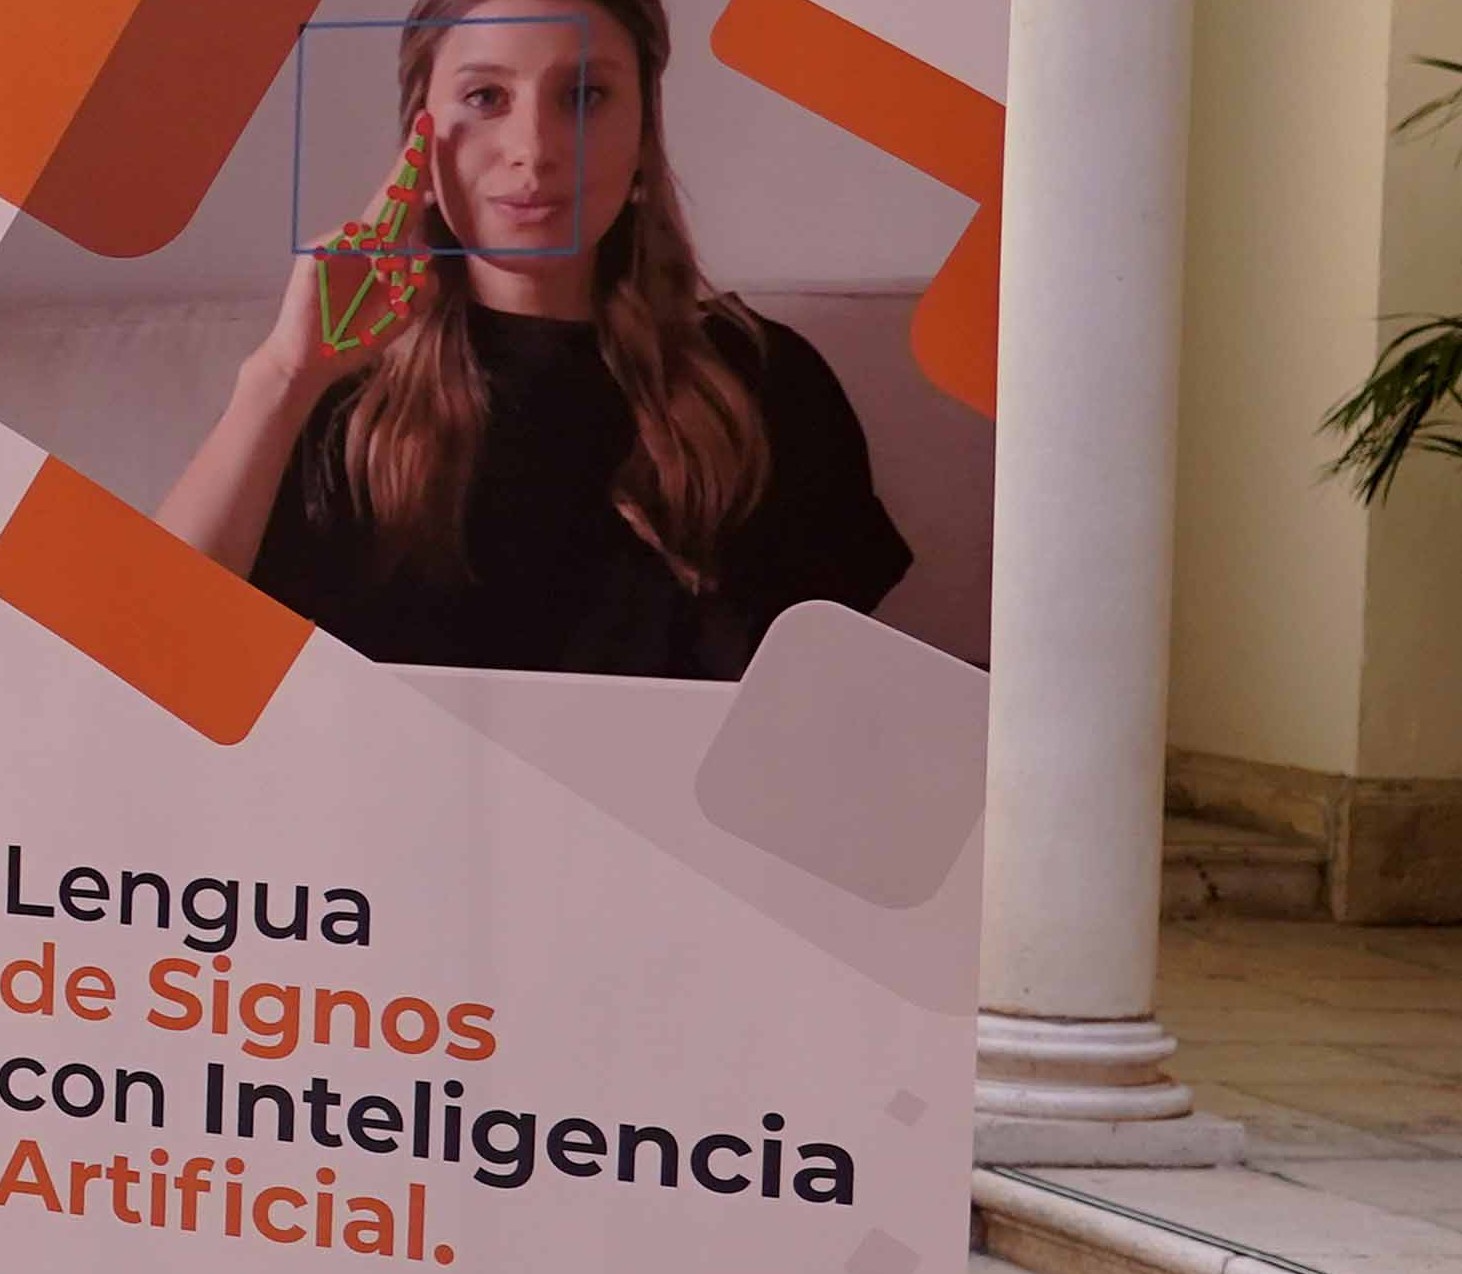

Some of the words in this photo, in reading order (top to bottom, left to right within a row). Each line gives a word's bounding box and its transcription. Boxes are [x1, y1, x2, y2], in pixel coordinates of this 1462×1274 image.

[7, 846, 370, 953] Lengua
[0, 942, 116, 1021] de
[147, 958, 496, 1061] Signos
[206, 1063, 854, 1205] Inteligencia
